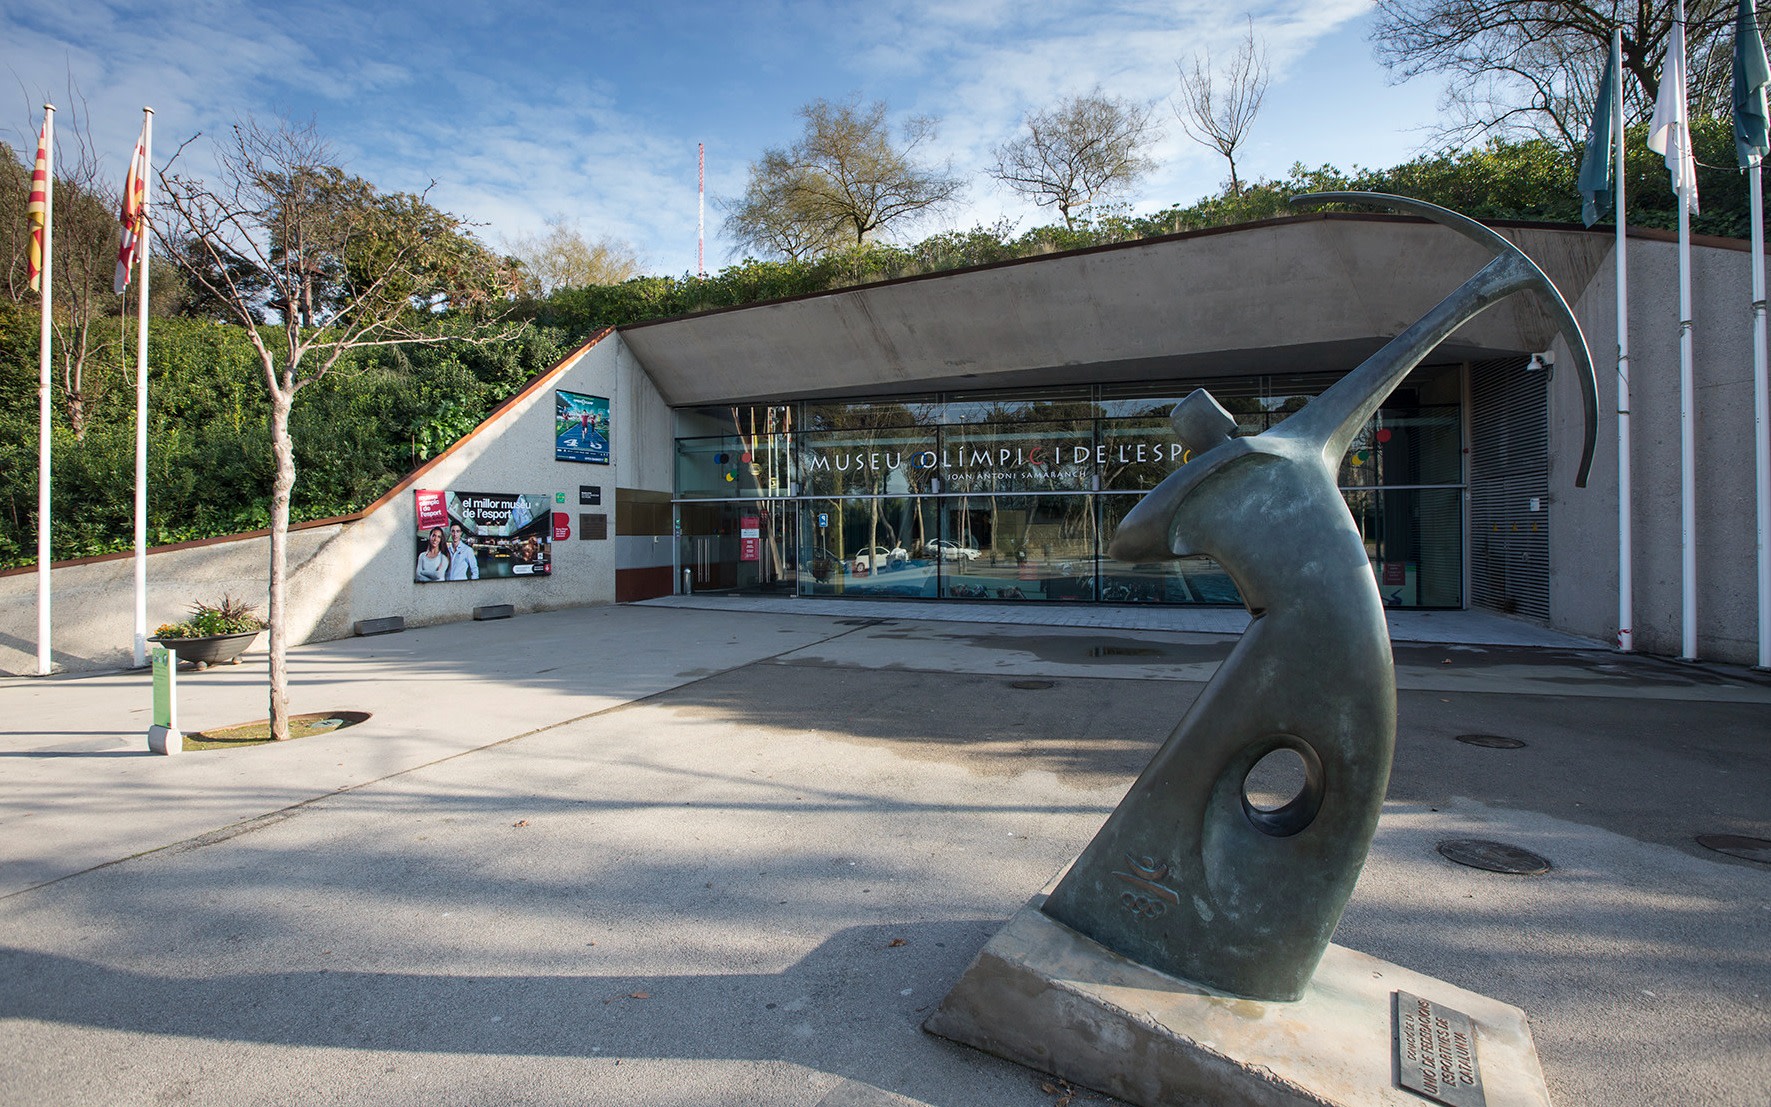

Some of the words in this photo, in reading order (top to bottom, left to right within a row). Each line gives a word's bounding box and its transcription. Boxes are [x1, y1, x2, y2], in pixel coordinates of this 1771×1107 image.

[810, 452, 901, 471] MUSEU
[1056, 447, 1059, 464] I
[1074, 445, 1106, 464] DE
[947, 473, 975, 481] JOAN
[977, 472, 1016, 480] ANTONI
[1021, 471, 1086, 479] SAMARANCH
[462, 498, 471, 508] el
[473, 498, 500, 508] millor
[501, 501, 531, 509] museu
[462, 508, 475, 518] de
[477, 508, 511, 520] l'esport
[1418, 1000, 1435, 1055] FEDERACIONS
[1436, 1017, 1449, 1030] DE
[1422, 1054, 1436, 1069] DE
[1436, 1029, 1457, 1087] ESPORTIVES
[1454, 1031, 1474, 1085] CATALUNYA
[1419, 1067, 1438, 1095] UNIÓ
